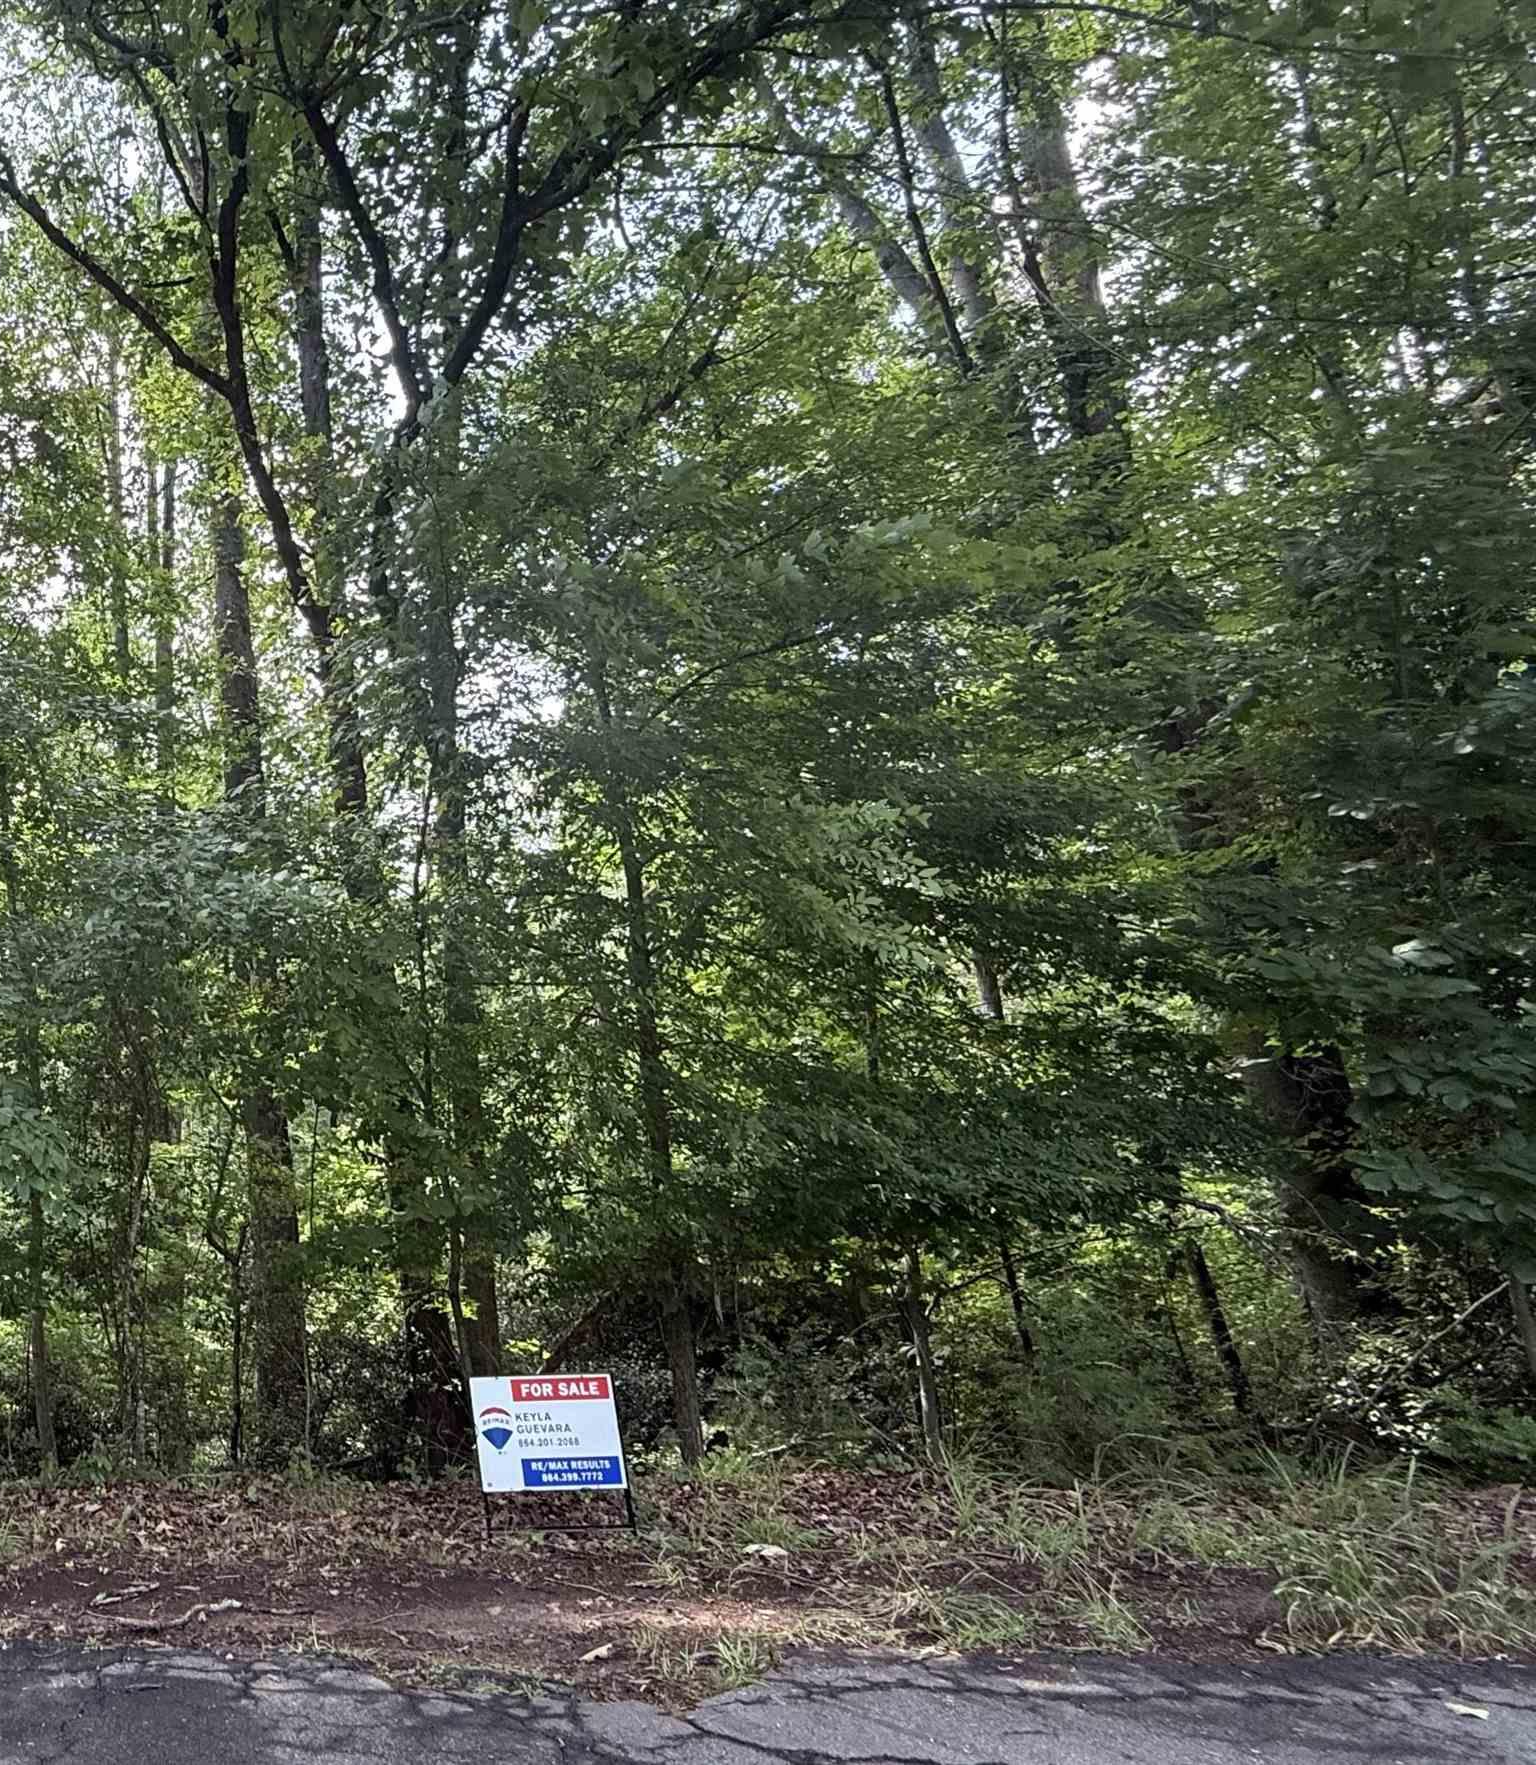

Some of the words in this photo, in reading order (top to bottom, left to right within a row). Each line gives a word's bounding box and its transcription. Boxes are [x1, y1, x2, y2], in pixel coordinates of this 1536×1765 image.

[520, 1382, 553, 1397] FOR
[558, 1381, 600, 1396] SALE
[515, 1412, 552, 1422] KEYLA
[516, 1423, 572, 1434] GUEVARA
[531, 1460, 569, 1471] RE/MAX
[570, 1459, 611, 1470] RESULTS
